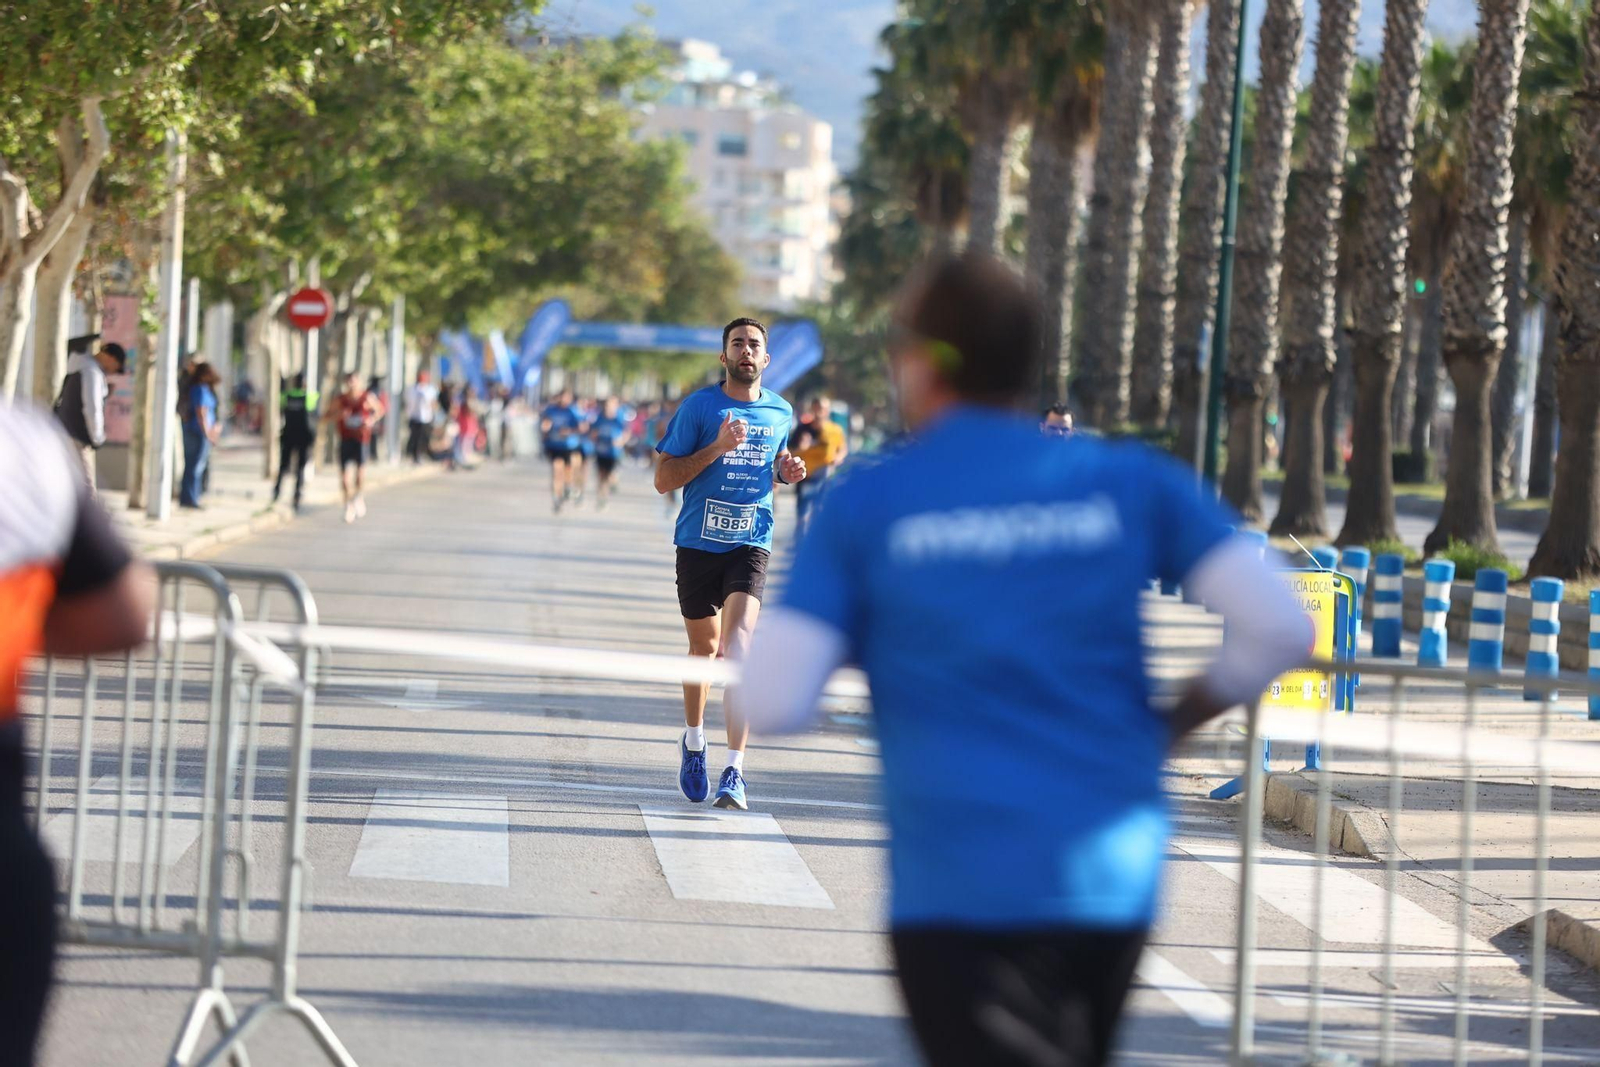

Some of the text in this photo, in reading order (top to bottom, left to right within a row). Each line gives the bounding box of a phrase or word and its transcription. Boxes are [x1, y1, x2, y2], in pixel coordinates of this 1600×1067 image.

[723, 450, 766, 459] MAKES
[722, 457, 766, 467] FRIENDS
[711, 516, 749, 530] 1983
[1282, 578, 1333, 593] OLICÍA LOCAL
